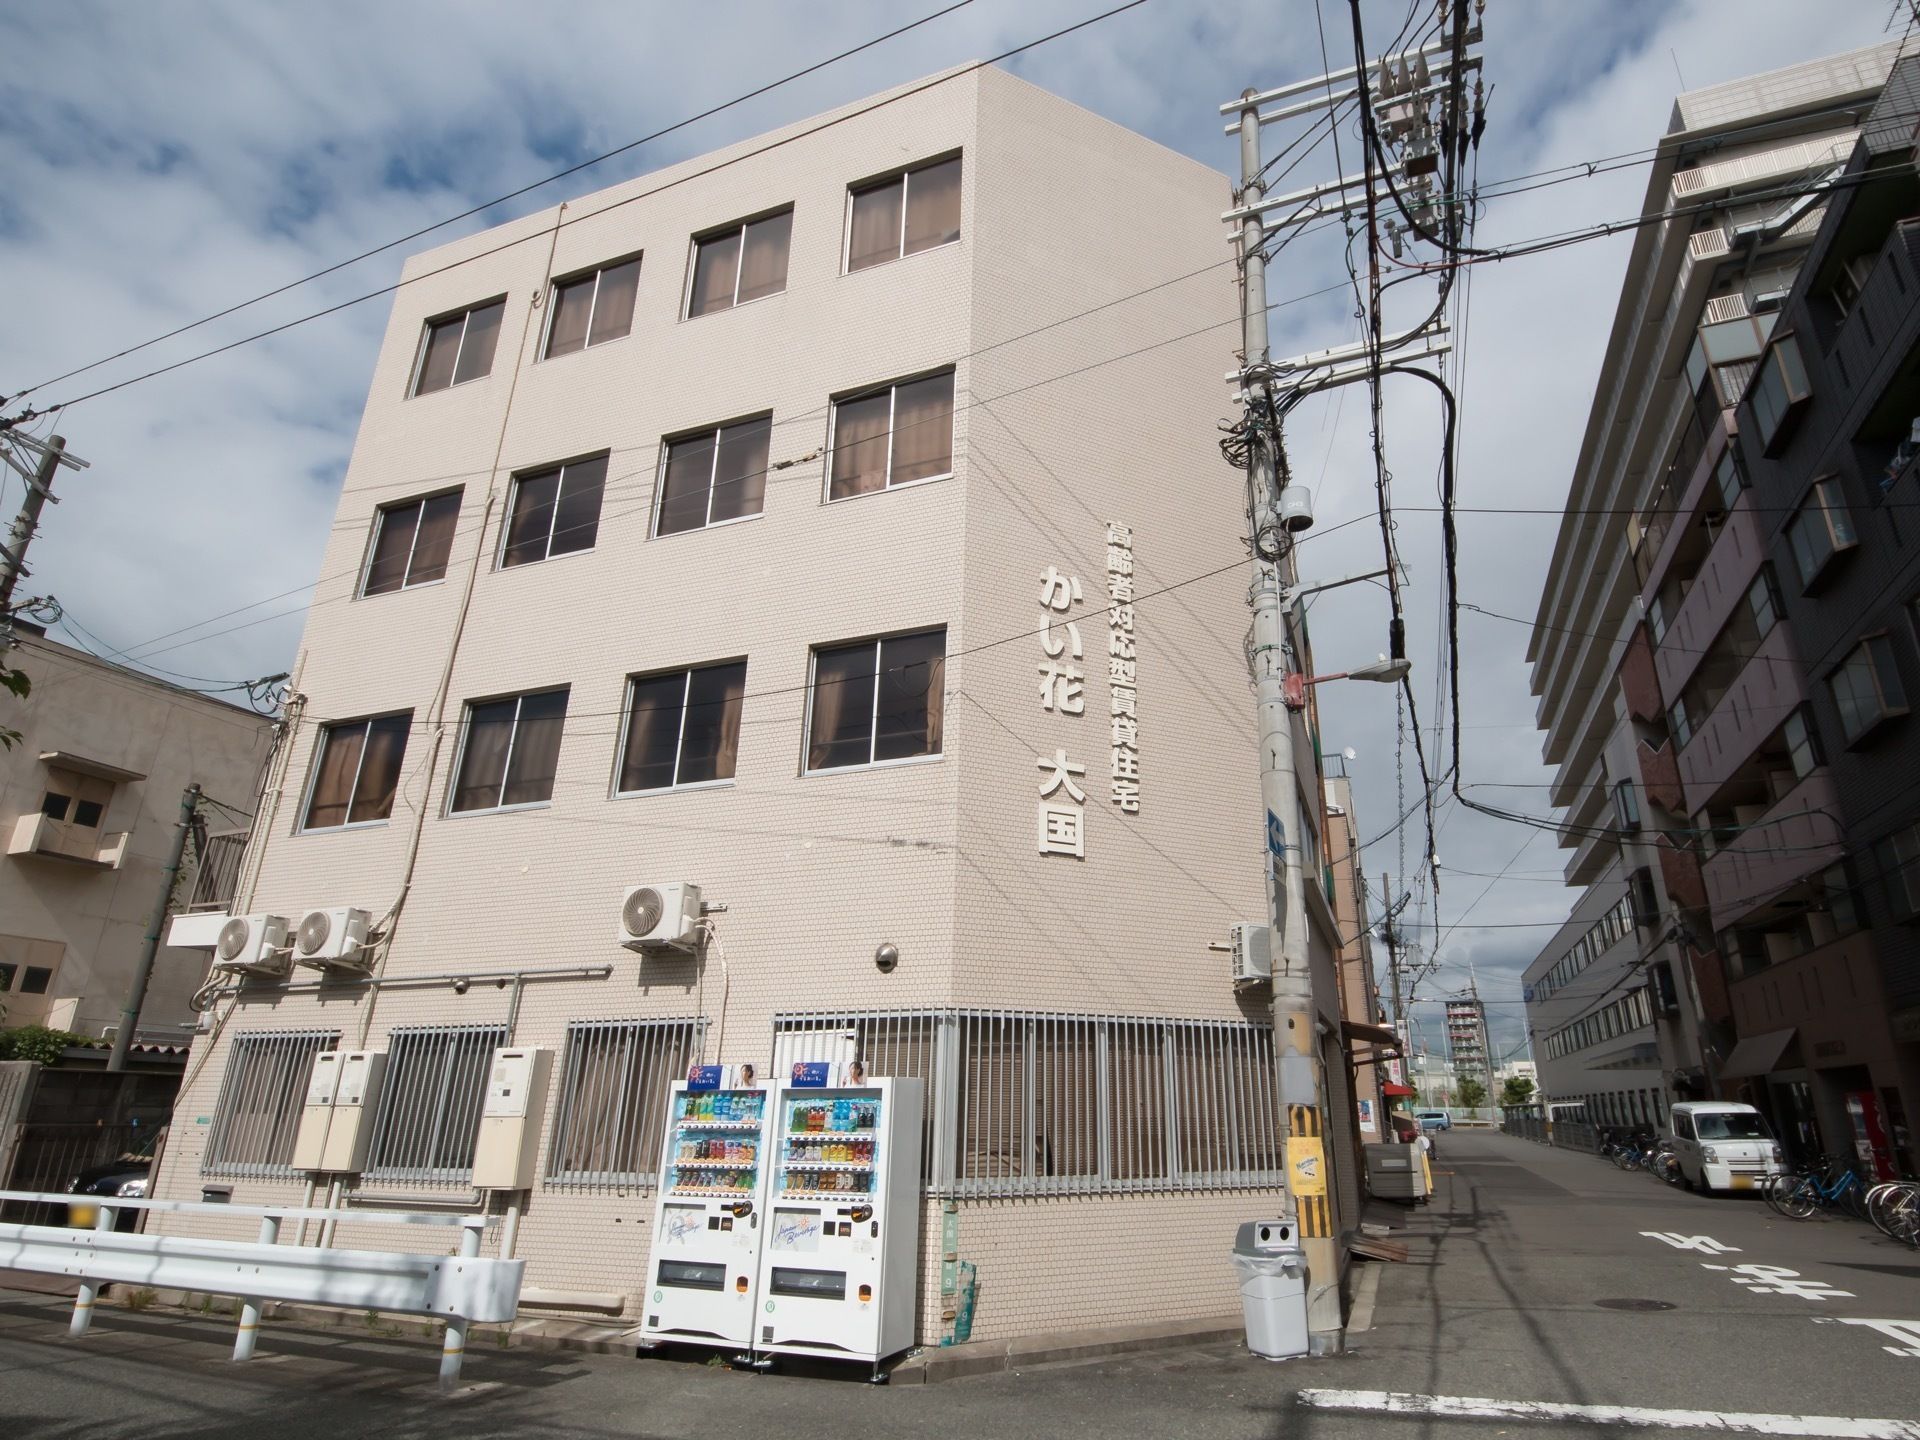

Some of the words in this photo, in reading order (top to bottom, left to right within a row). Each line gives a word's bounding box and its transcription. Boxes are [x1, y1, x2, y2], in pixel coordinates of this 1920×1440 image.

[1039, 566, 1085, 713] かい花
[1106, 521, 1139, 813] 高齢者対応型賃貸住宅
[1038, 748, 1086, 858] 大国
